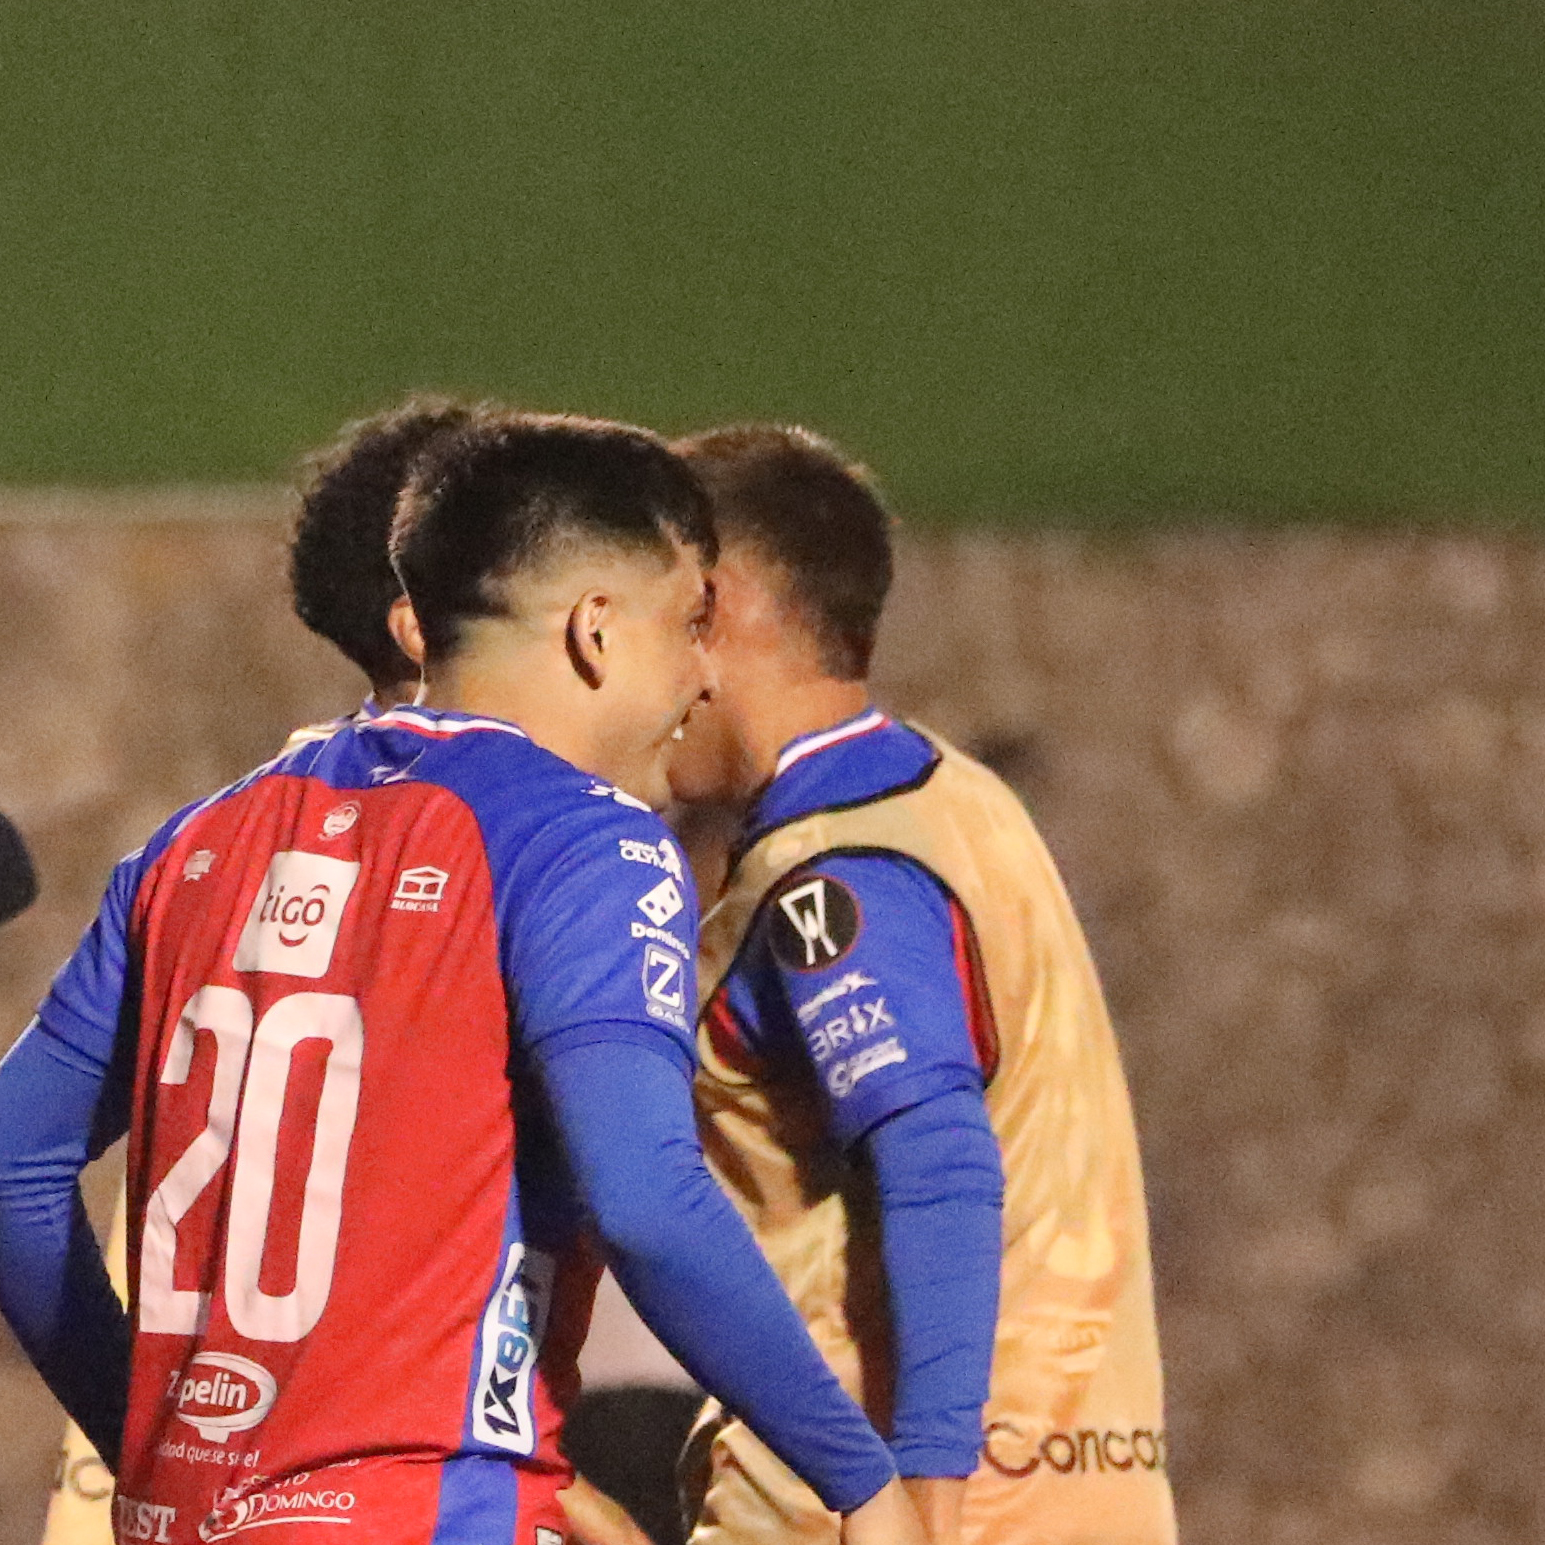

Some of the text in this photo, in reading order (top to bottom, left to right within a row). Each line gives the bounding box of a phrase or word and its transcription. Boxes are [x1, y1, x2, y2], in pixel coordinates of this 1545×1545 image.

[138, 985, 365, 1343] 20
[984, 1421, 1167, 1480] Conca
[246, 1490, 356, 1523] DOMINGO
